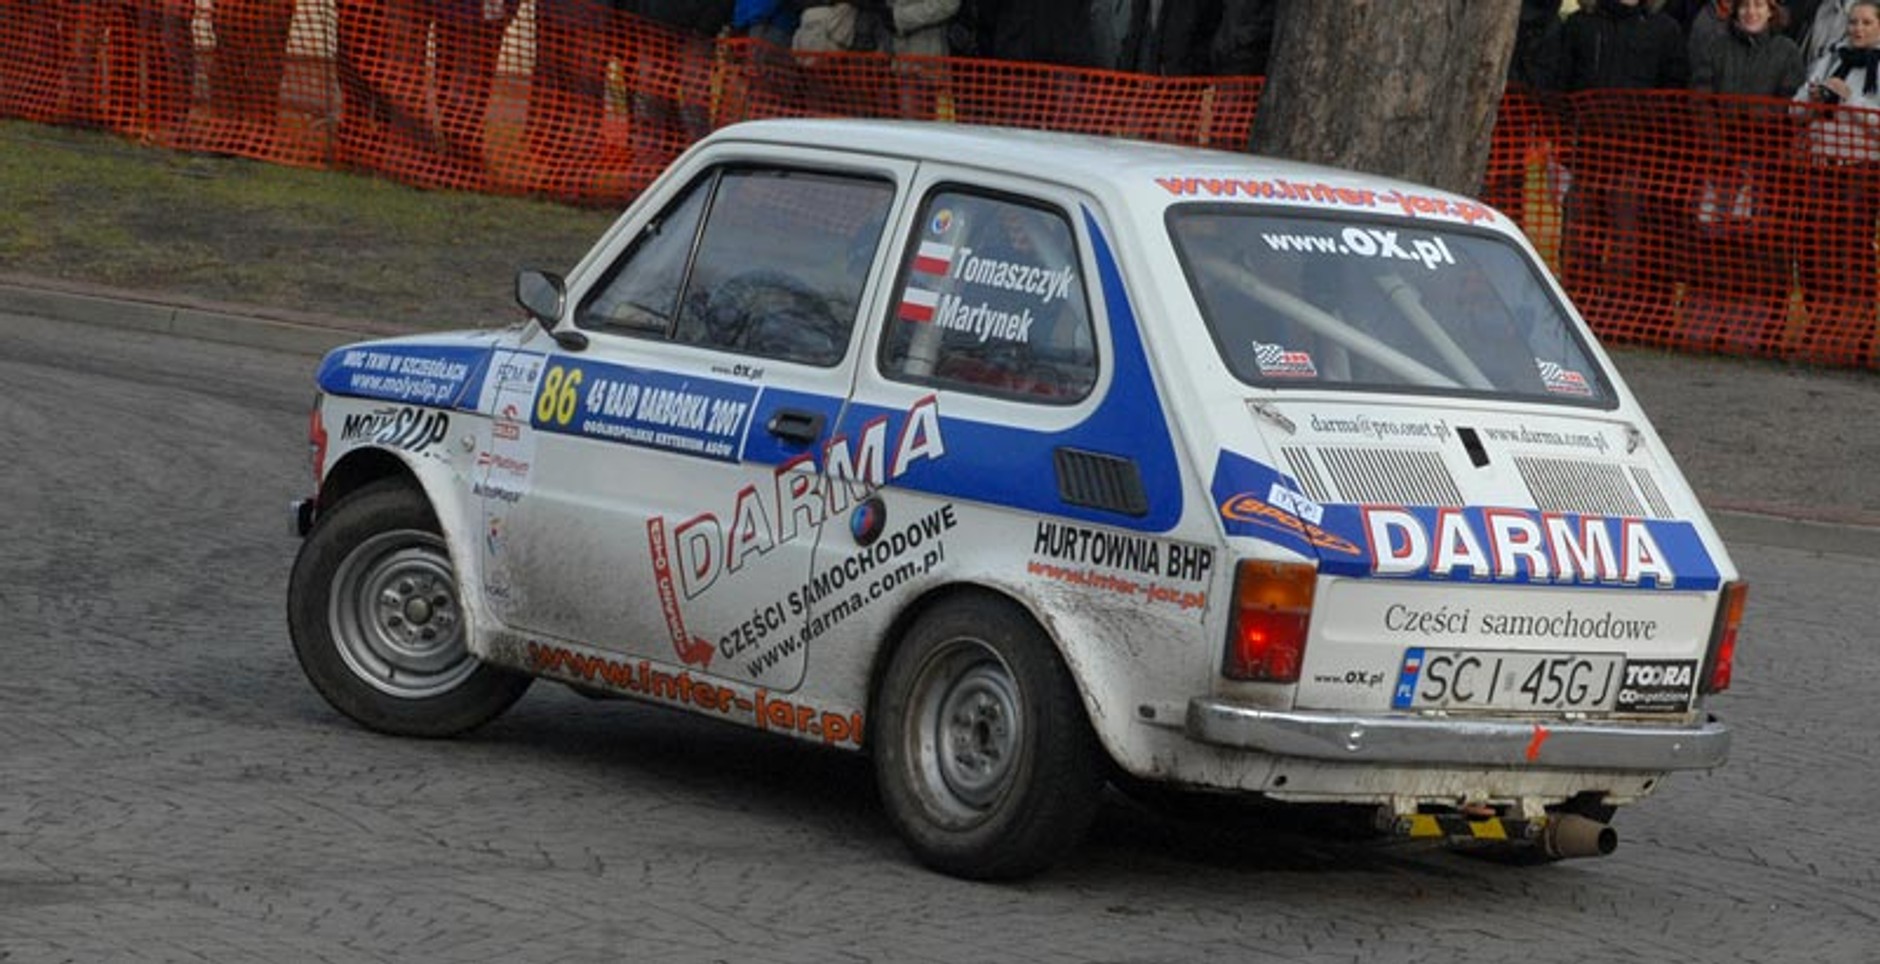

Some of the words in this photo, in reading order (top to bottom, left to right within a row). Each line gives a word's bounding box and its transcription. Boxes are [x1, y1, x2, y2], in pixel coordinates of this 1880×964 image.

[1154, 177, 1496, 224] www.inter-jar.pl
[954, 248, 1074, 303] Tomaszczyk
[936, 294, 1034, 343] Martynek
[350, 373, 455, 402] www.molyslip.pl
[536, 365, 584, 425] 86
[586, 378, 608, 414] 45
[603, 381, 641, 418] RAJD
[636, 381, 709, 431] BARBÓRKA
[706, 398, 748, 437] 2007
[1311, 413, 1451, 442] darma@pro.onet.pl
[1484, 424, 1610, 454] www.darma.com.pl
[674, 394, 945, 602] DARMA
[1034, 522, 1160, 575] HURTOWNIA
[1167, 543, 1212, 581] BHP
[1361, 504, 1675, 589] DARMA
[718, 603, 787, 660] CZĘŚCI
[791, 504, 957, 614] SAMOCHODOWE
[1028, 560, 1206, 611] www.inter-jar.pl
[747, 542, 944, 680] www.darma.com.pl
[1385, 604, 1468, 635] Części
[1481, 611, 1657, 640] samochodowe
[527, 641, 864, 745] www.inter-jar.pl
[1397, 684, 1412, 697] PL
[1625, 665, 1691, 686] TOORA
